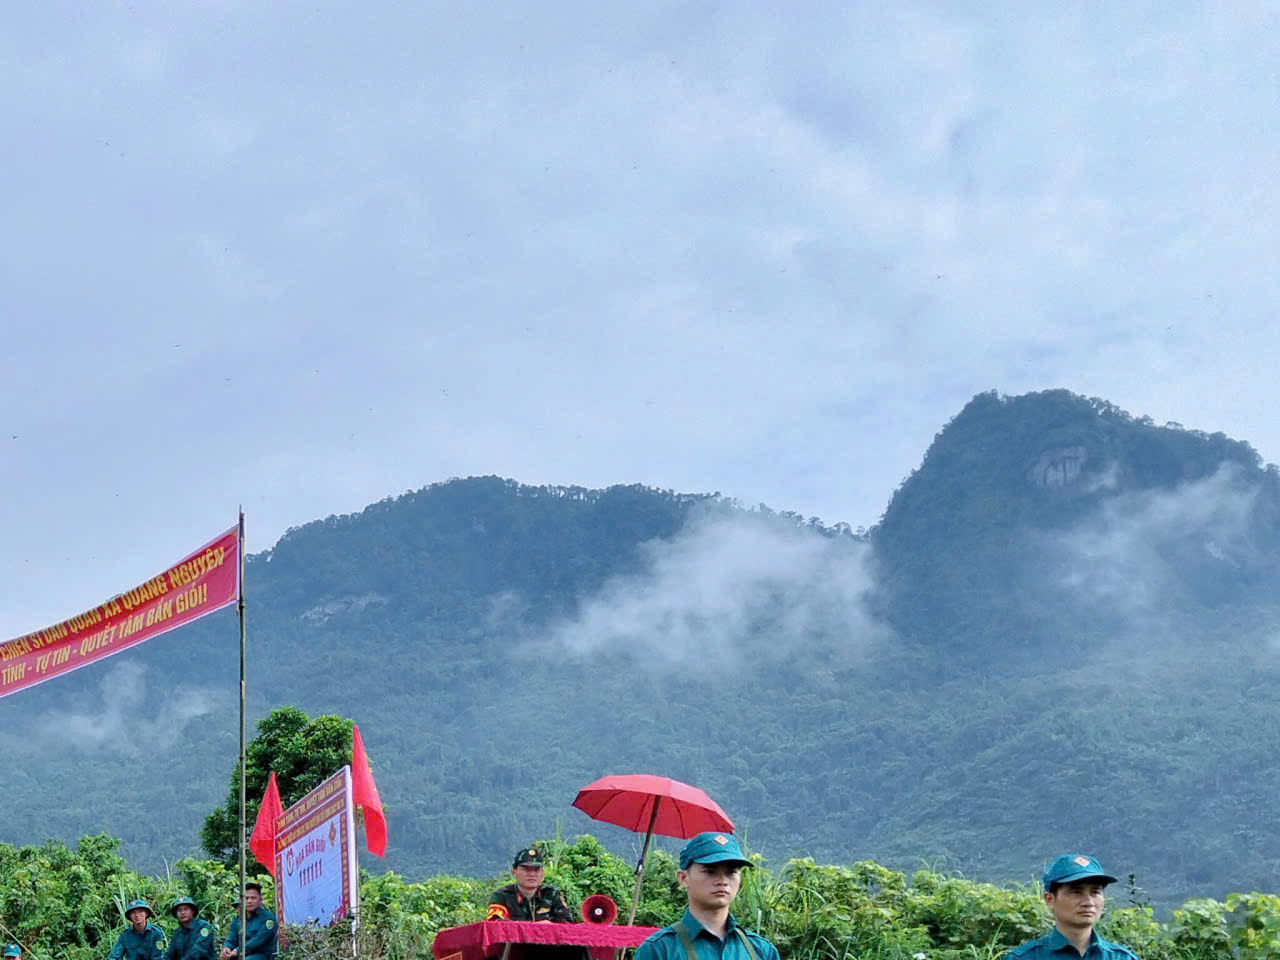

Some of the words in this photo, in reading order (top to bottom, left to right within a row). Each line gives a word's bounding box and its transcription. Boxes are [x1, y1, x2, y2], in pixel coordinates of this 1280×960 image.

[168, 546, 225, 588] NGUYÊN
[36, 651, 52, 674] TỰ
[52, 645, 71, 667] TIN
[80, 622, 118, 656] QUYẾT
[119, 615, 144, 639] TÂM
[176, 582, 208, 614] GIỎI!
